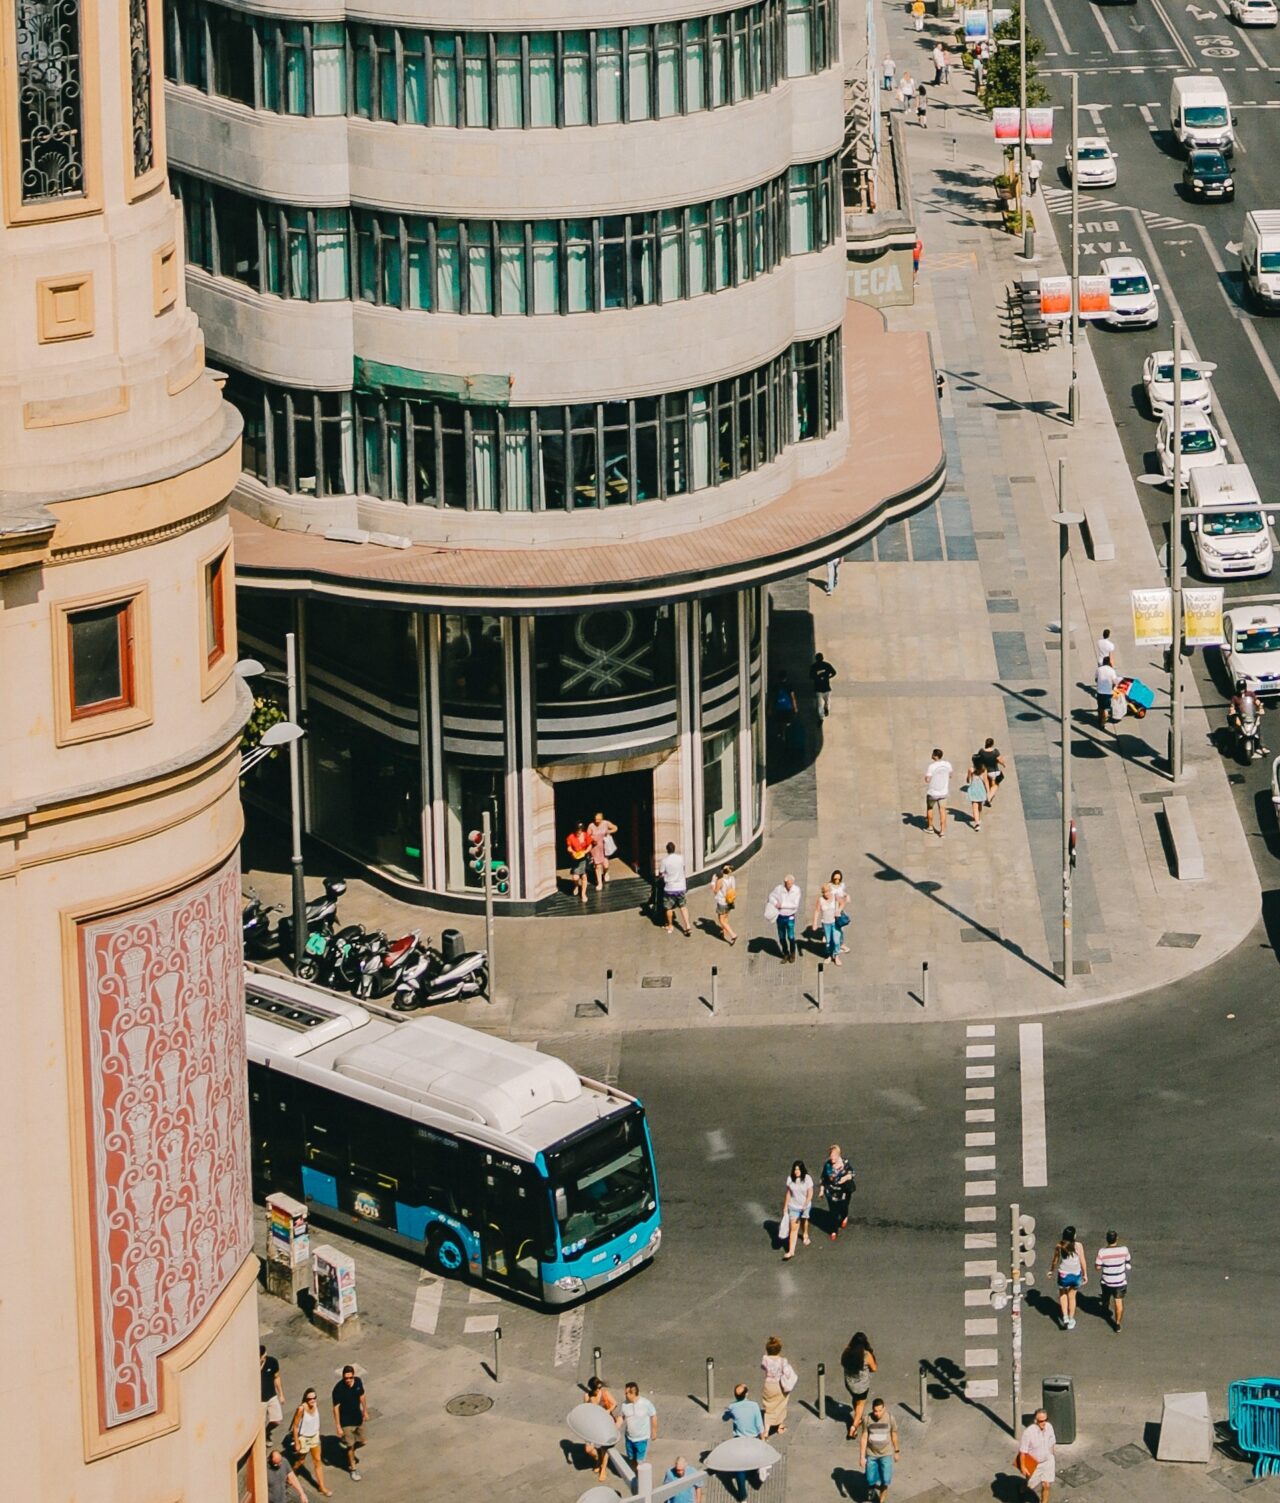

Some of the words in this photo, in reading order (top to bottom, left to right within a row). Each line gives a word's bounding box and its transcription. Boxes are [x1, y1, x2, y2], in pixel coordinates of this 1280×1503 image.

[1068, 220, 1120, 233] BUS
[1187, 602, 1211, 611] Mayor
[1135, 611, 1164, 620] Orgullo
[1187, 611, 1216, 620] Orgullo
